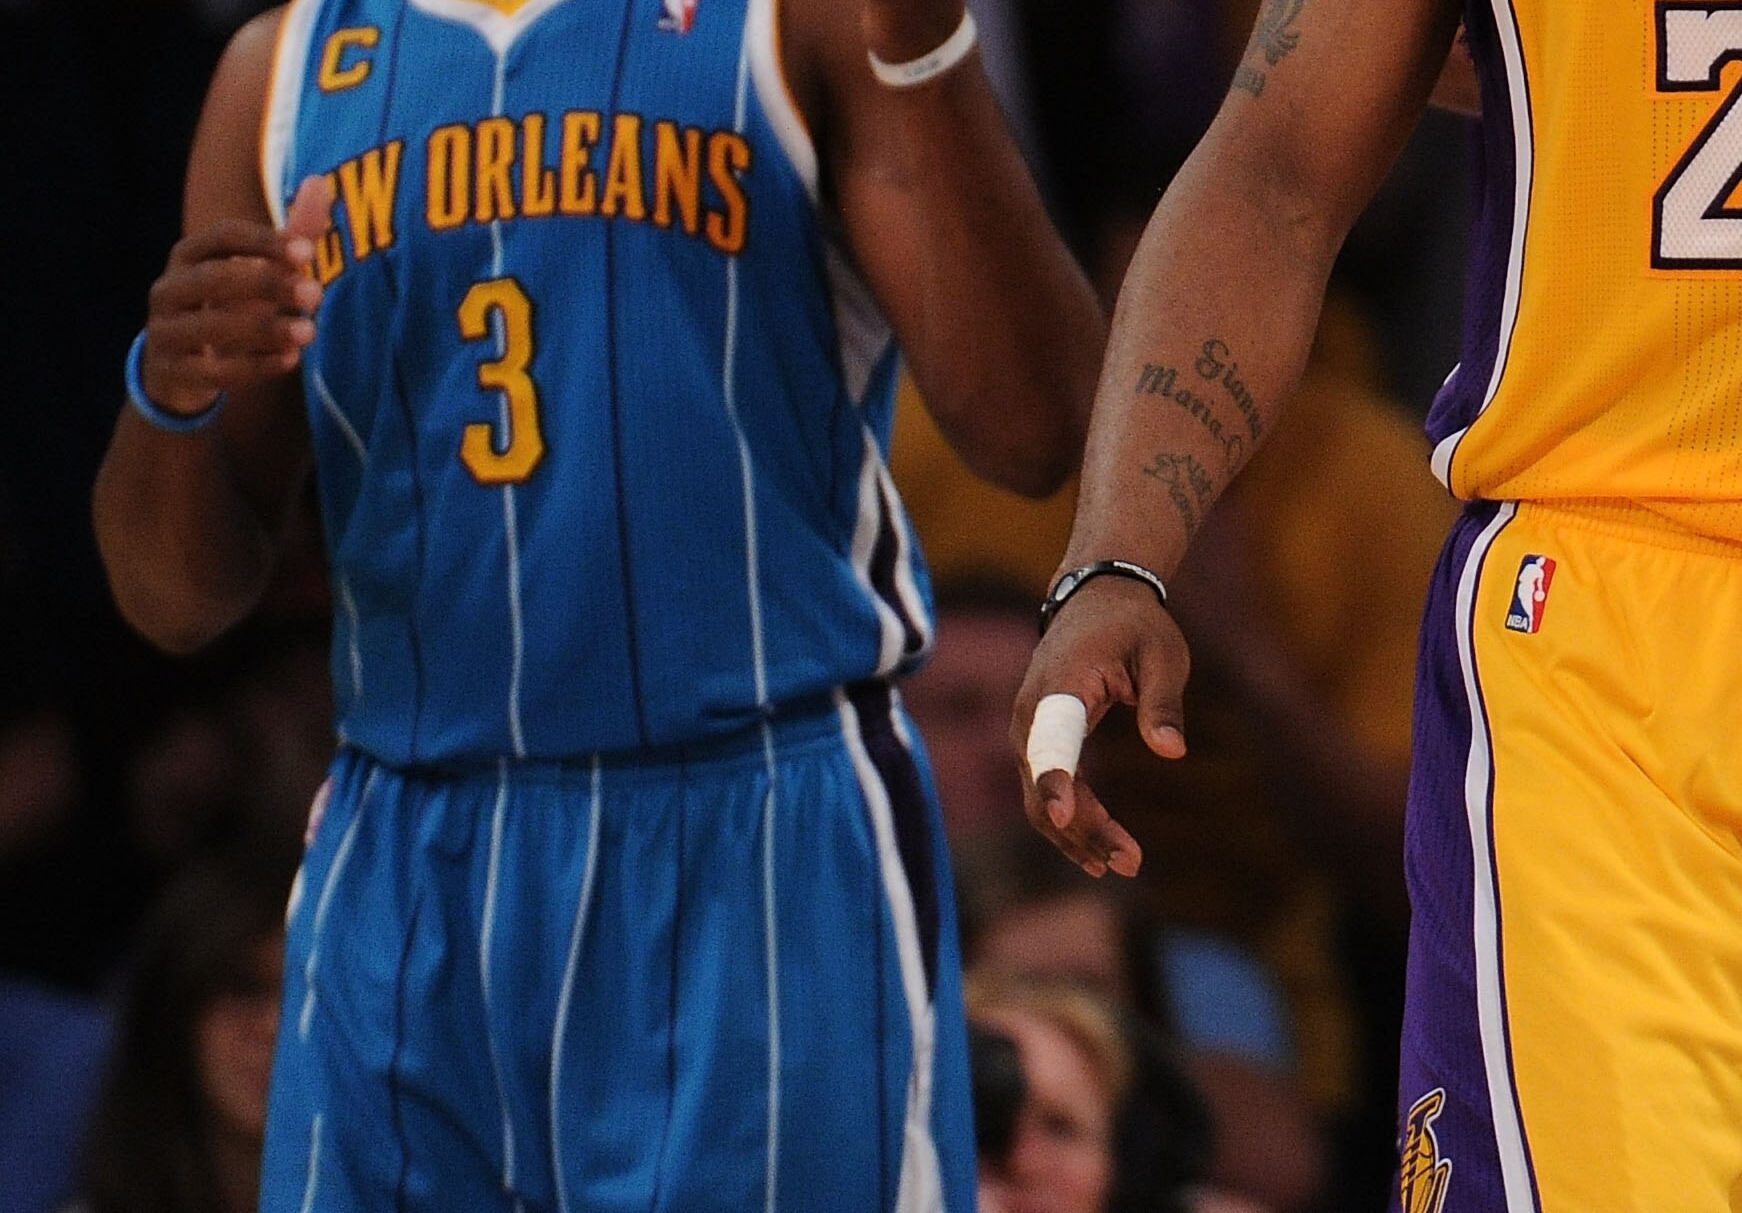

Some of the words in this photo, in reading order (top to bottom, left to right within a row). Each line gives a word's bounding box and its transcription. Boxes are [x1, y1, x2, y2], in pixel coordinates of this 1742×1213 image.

[317, 25, 381, 92] C
[425, 110, 754, 258] ORLEANS
[456, 276, 547, 485] 3
